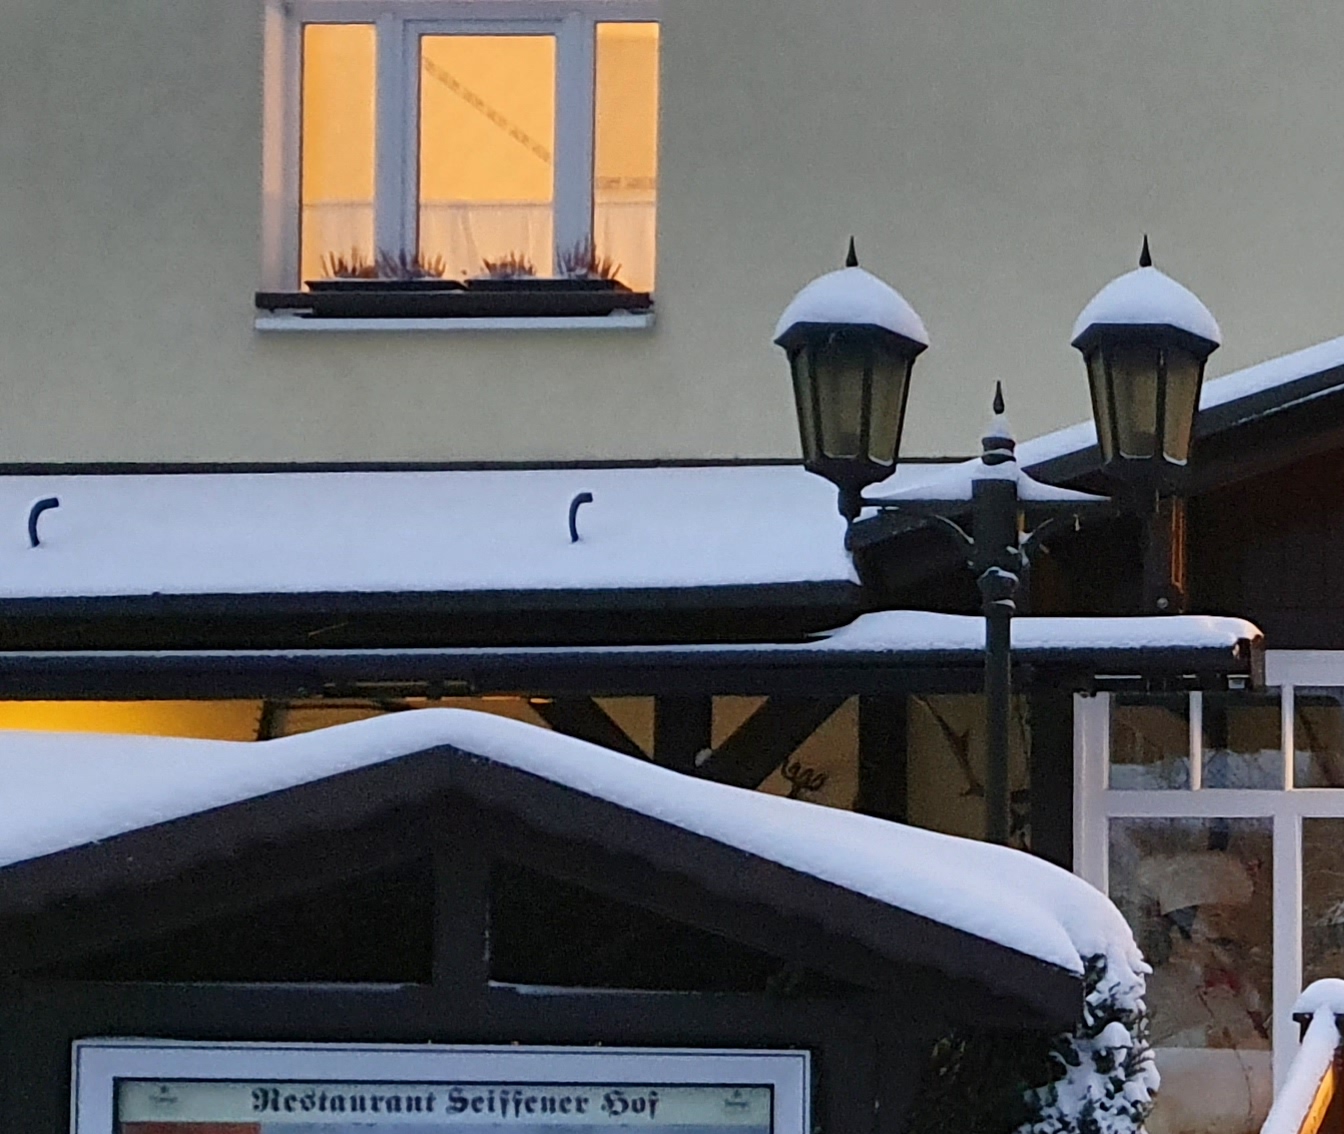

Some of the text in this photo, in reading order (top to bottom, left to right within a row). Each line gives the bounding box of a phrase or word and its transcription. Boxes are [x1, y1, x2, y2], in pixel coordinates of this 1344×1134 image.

[250, 1087, 660, 1119] Restaurant Seiffener Hof
